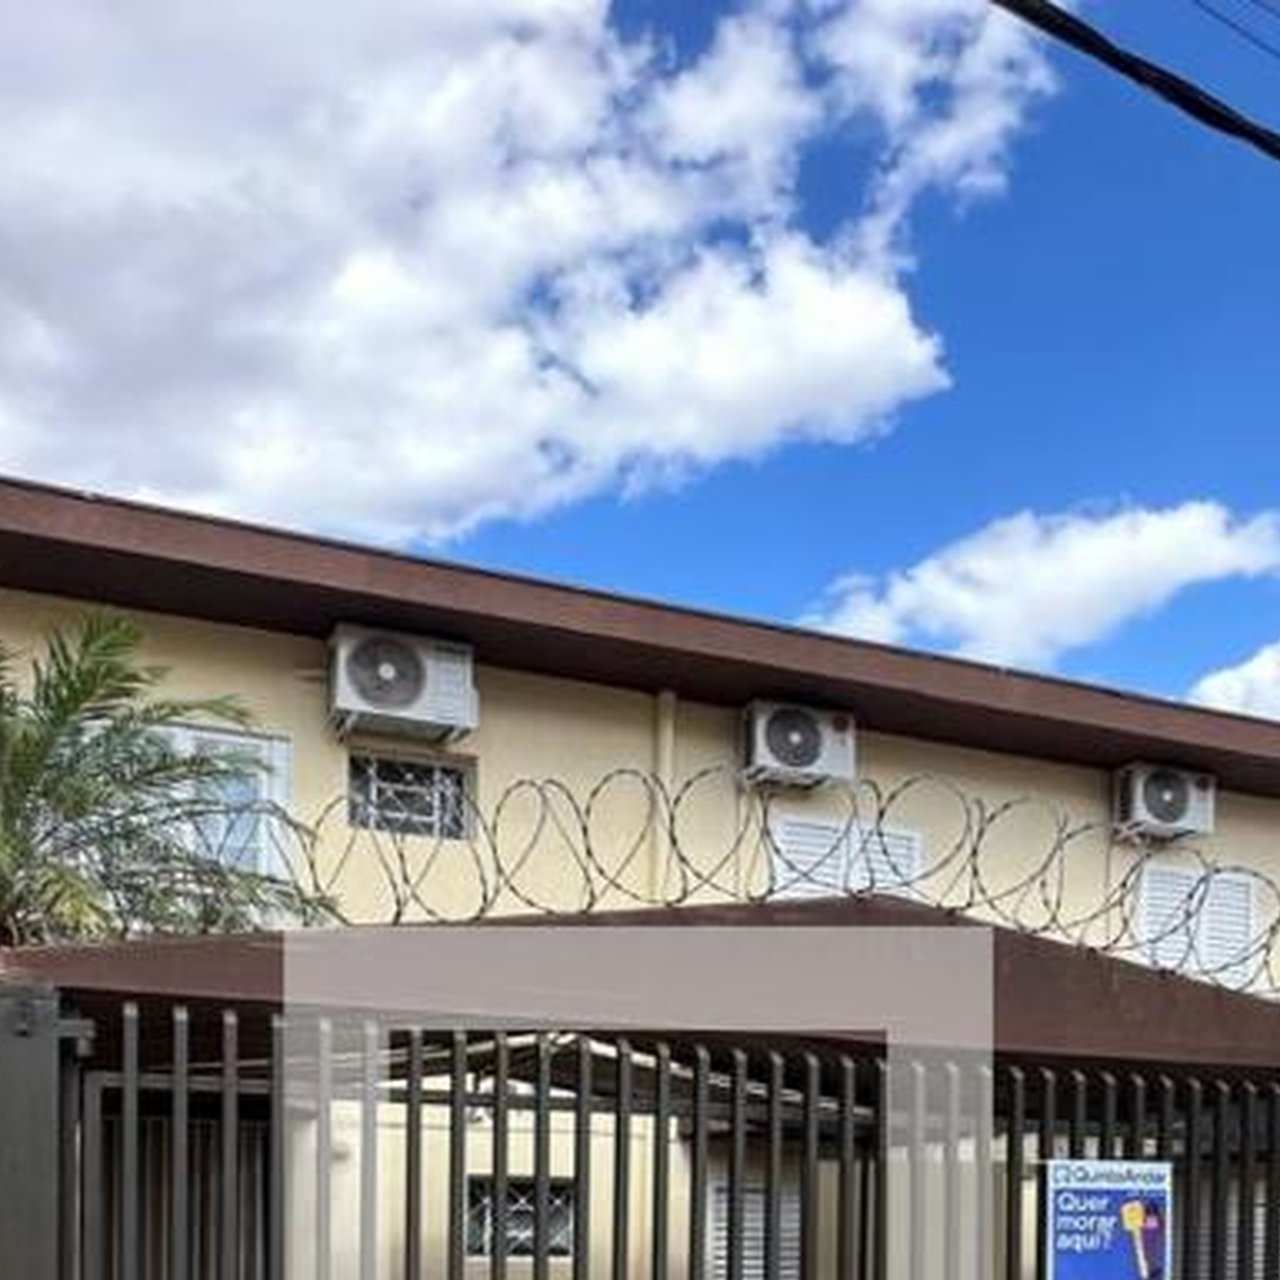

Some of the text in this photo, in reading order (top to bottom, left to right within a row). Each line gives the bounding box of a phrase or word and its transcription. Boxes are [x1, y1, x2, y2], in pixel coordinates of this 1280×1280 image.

[1057, 1192, 1109, 1212] Quer
[1056, 1215, 1117, 1231] morar
[1056, 1232, 1112, 1252] aqui?
